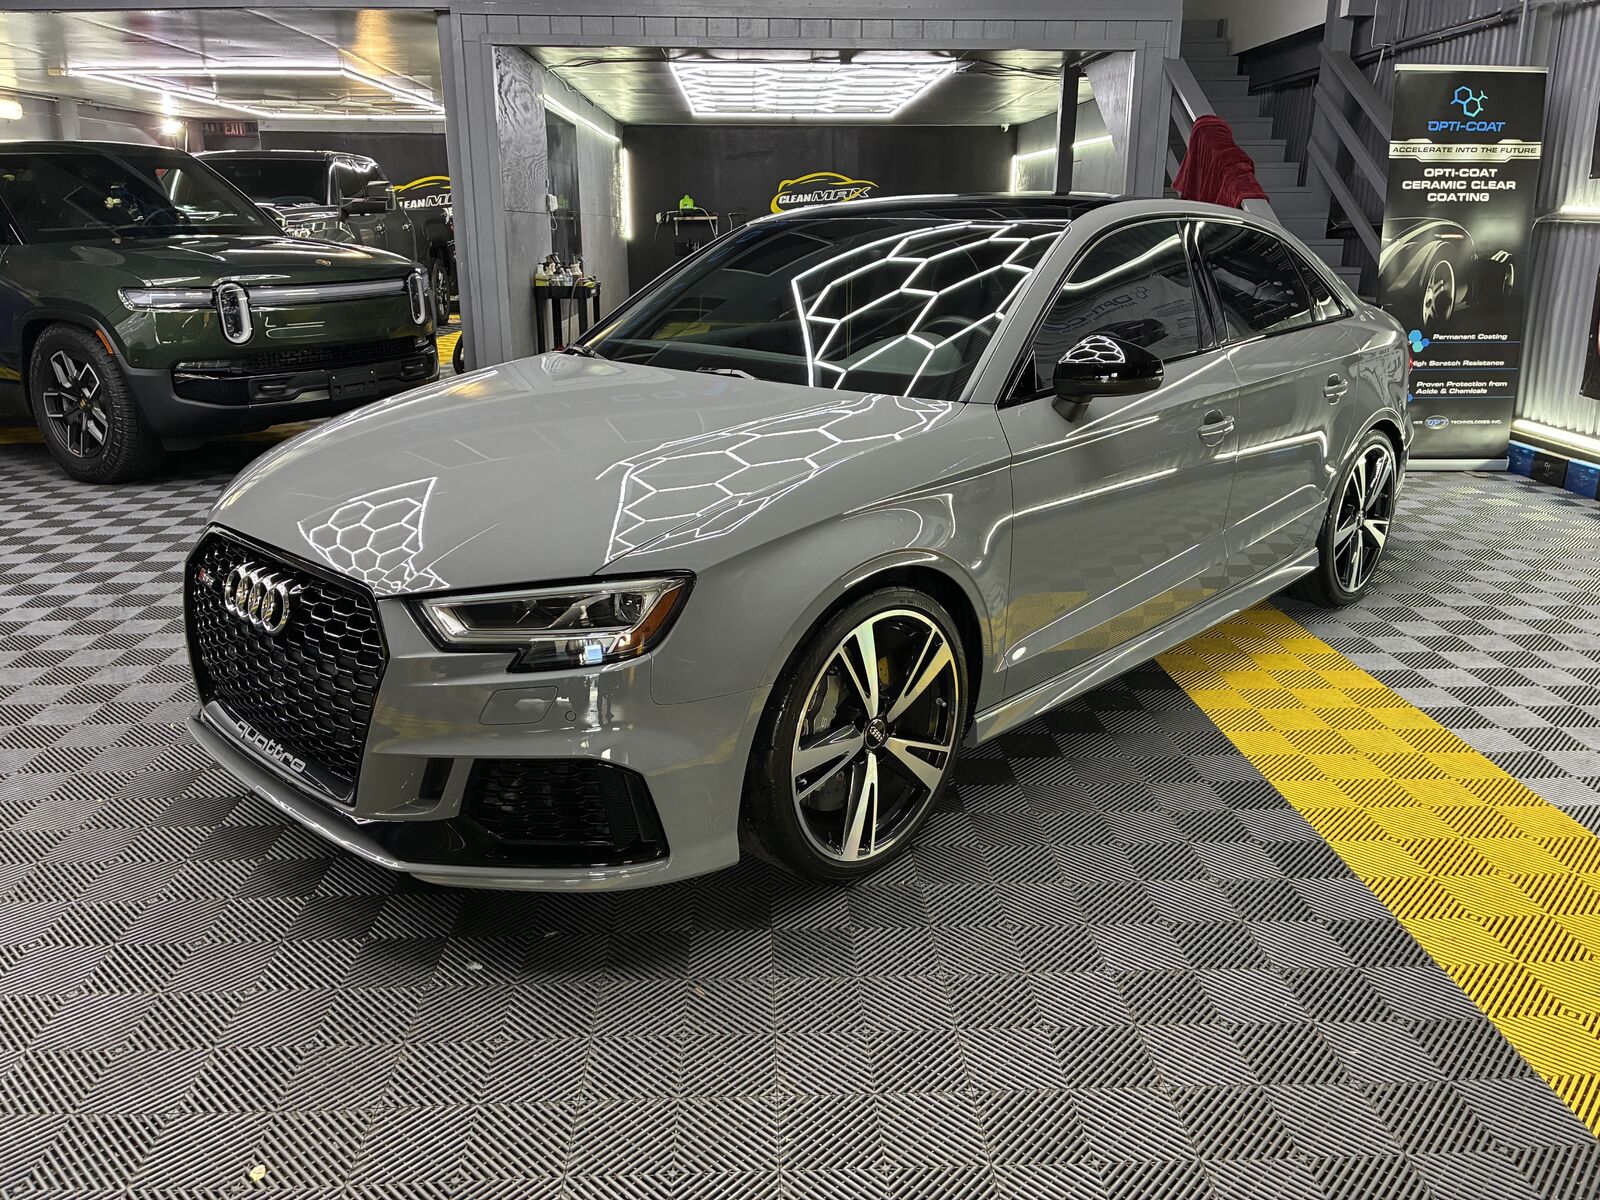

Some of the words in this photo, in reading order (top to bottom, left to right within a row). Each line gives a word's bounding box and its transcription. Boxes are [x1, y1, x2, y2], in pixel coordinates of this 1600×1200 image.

[1427, 121, 1506, 132] OPTI-COAT
[1423, 168, 1498, 178] OPTI-COAT
[1402, 180, 1467, 190] CERAMIC
[1471, 180, 1516, 190] CLEAR
[1427, 192, 1490, 202] COATING
[1477, 333, 1508, 341] Coating
[236, 720, 307, 773] quattro
